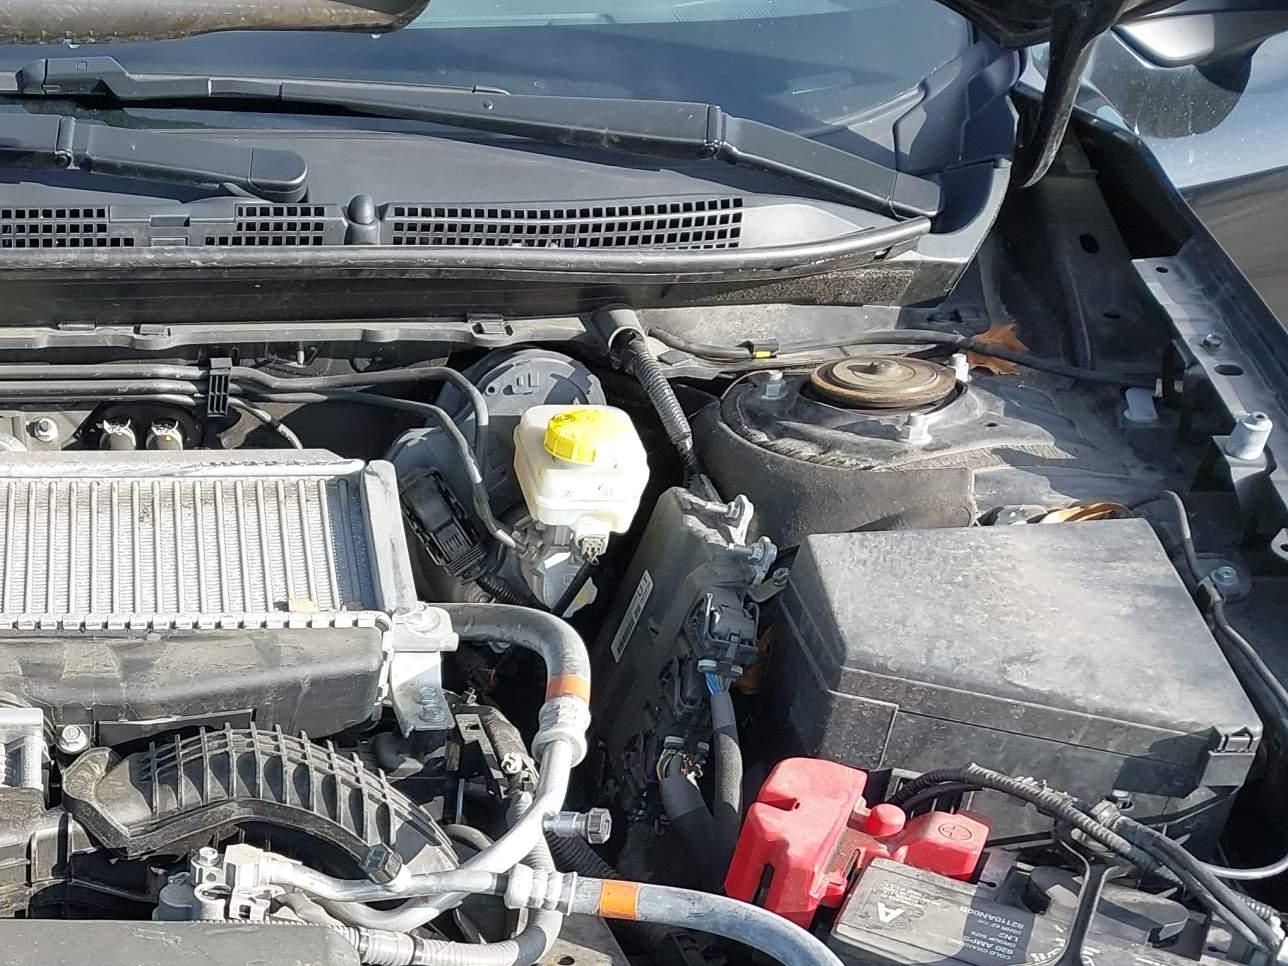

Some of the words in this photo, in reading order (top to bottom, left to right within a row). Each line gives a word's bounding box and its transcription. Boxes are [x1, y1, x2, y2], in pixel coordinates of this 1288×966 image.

[877, 902, 905, 923] A
[963, 936, 993, 951] AMPS
[996, 931, 1019, 943] LN2
[995, 944, 1015, 956] 620
